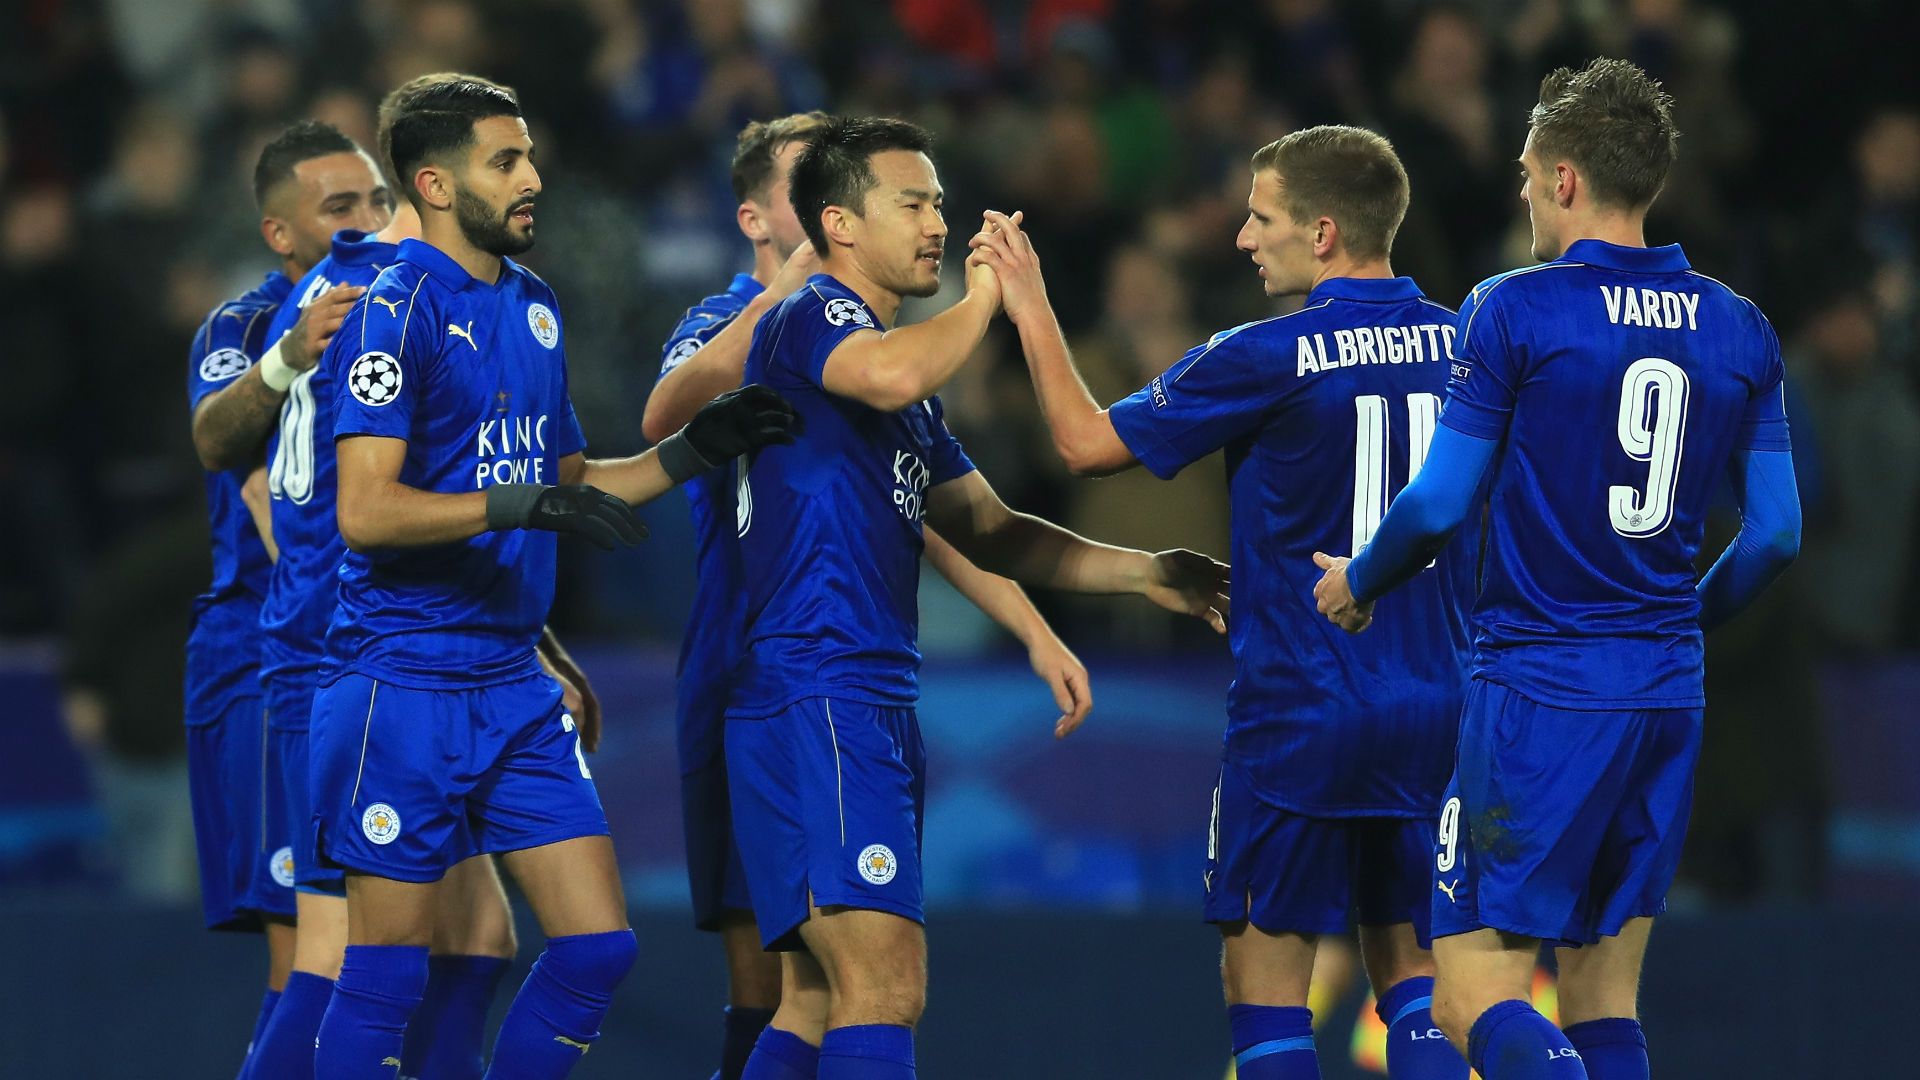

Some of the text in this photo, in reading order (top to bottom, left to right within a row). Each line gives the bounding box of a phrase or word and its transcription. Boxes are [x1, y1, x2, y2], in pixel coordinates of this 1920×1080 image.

[1600, 285, 1700, 331] VARDY
[1608, 357, 1690, 539] 9
[1437, 797, 1461, 872] 9
